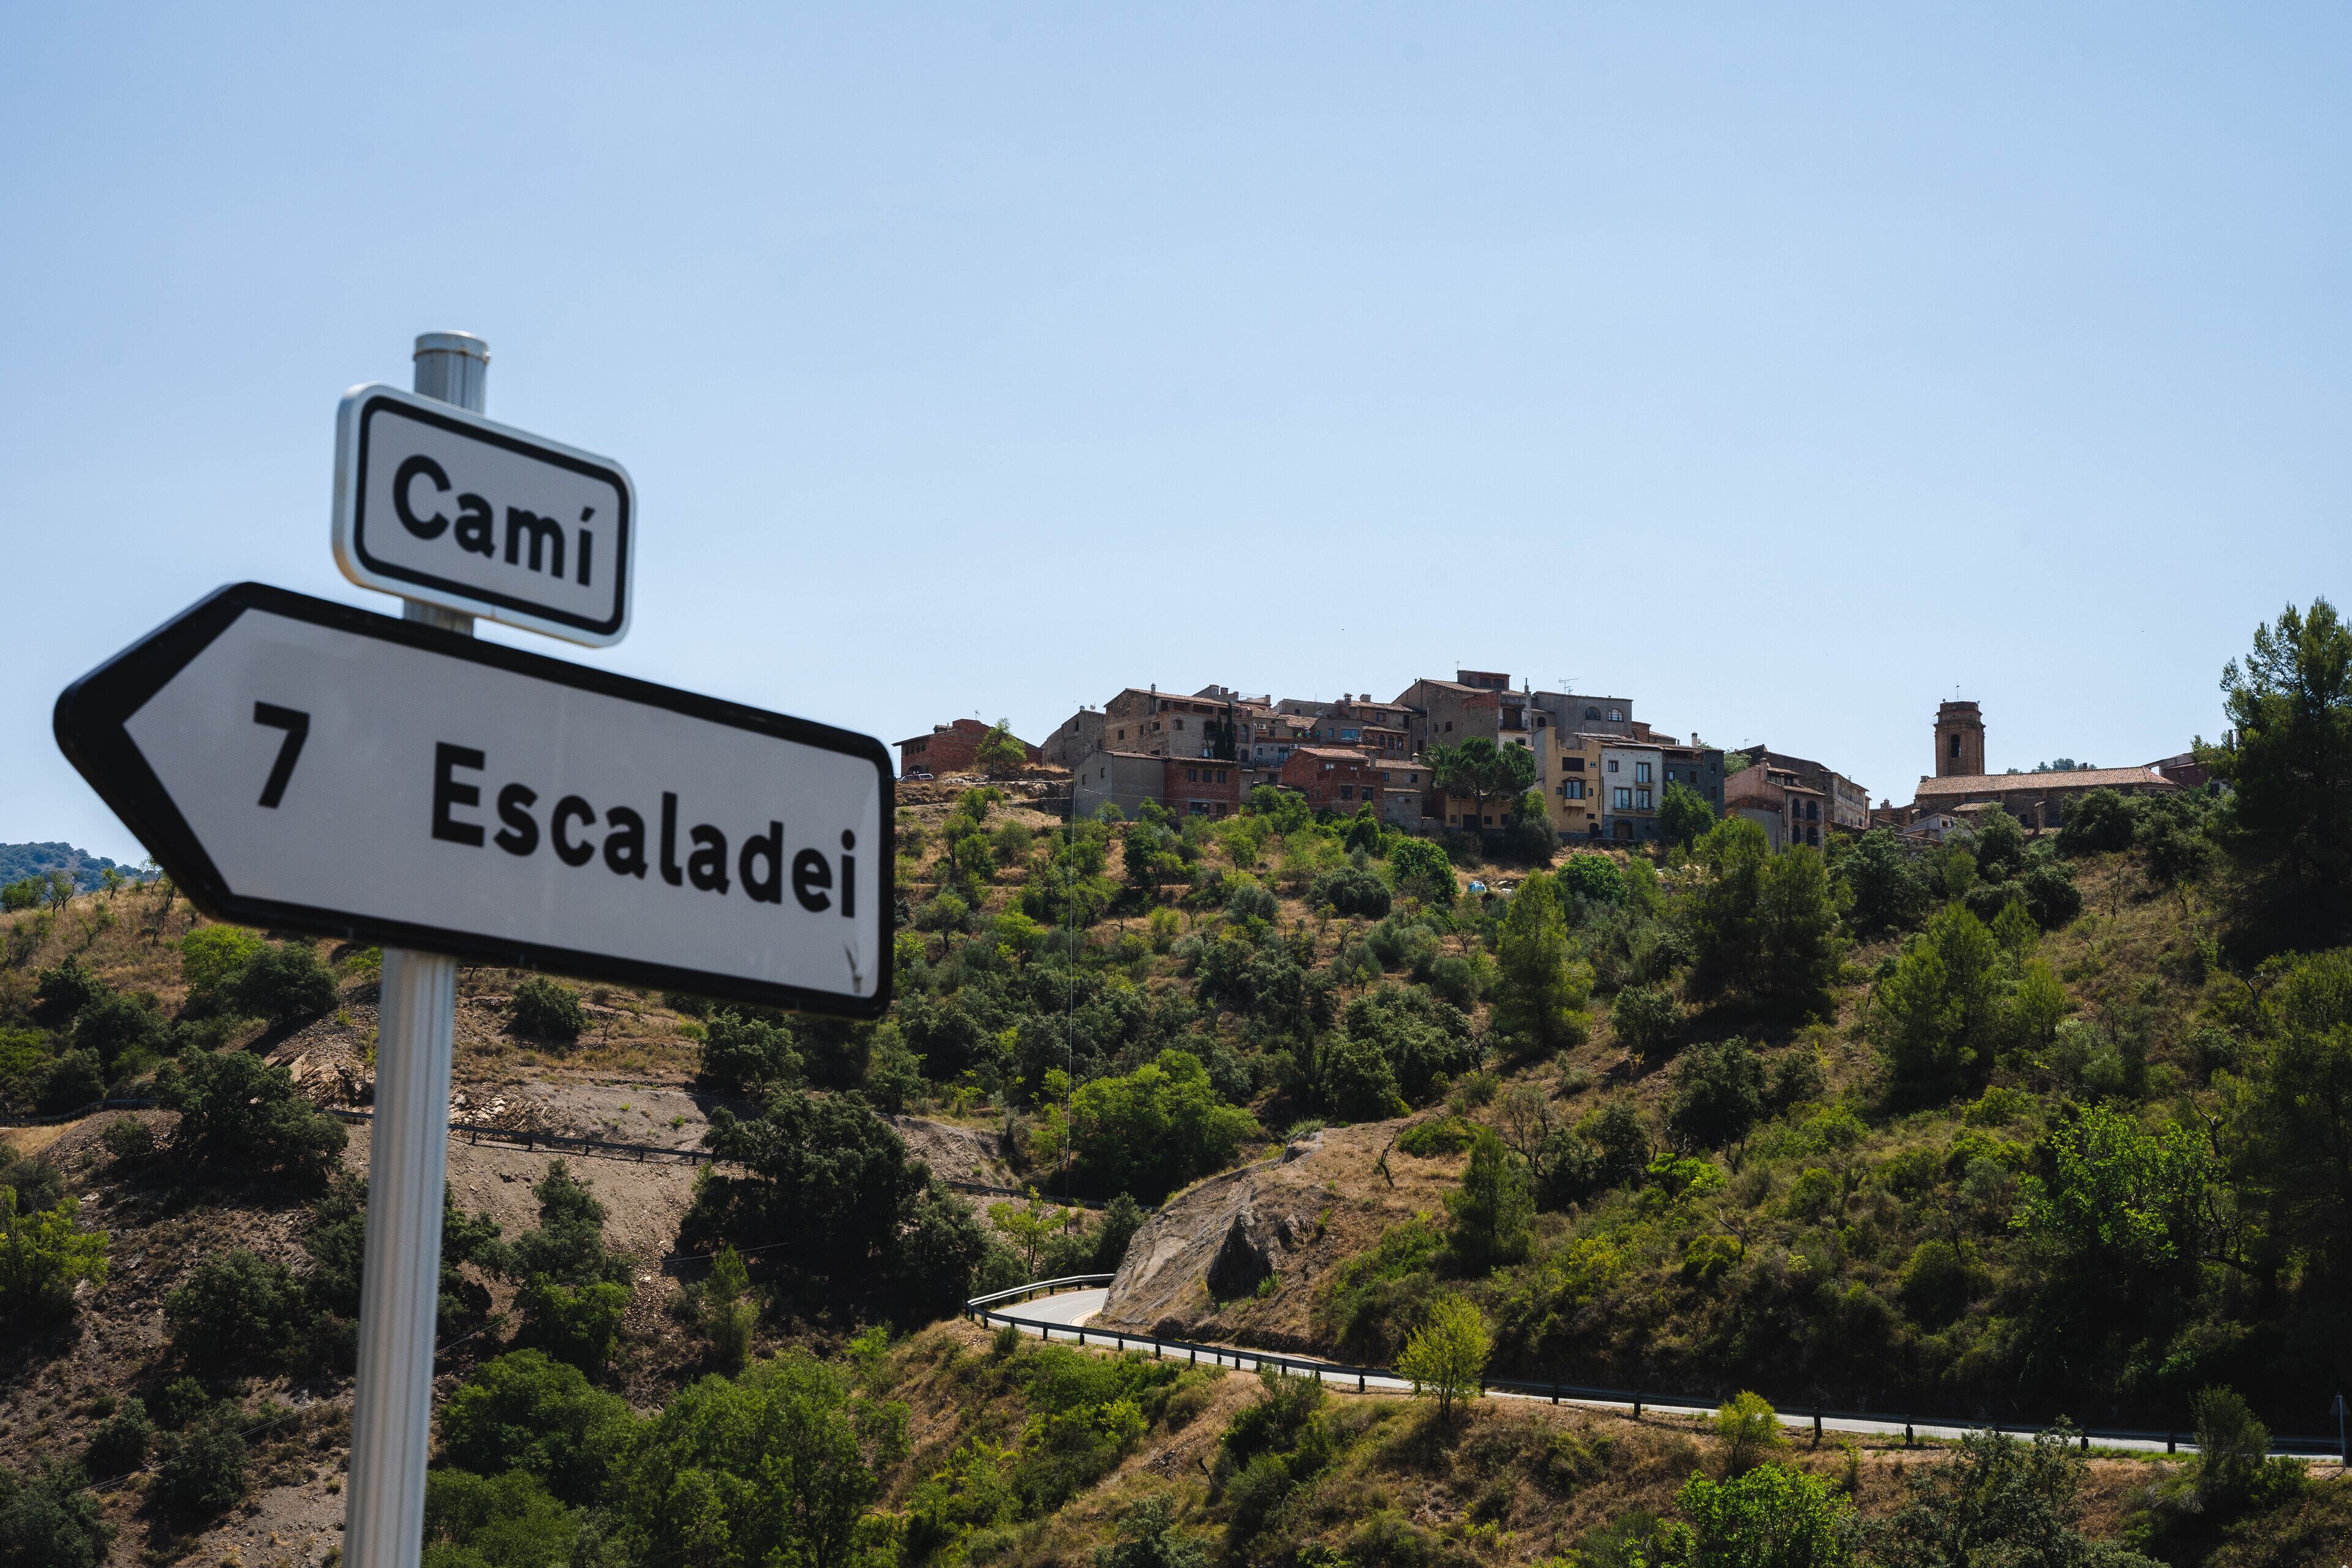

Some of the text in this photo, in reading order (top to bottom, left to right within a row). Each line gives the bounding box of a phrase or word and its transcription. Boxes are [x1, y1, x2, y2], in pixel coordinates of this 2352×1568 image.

[392, 454, 596, 587] Camí
[252, 698, 856, 919] 7 Escaladei
